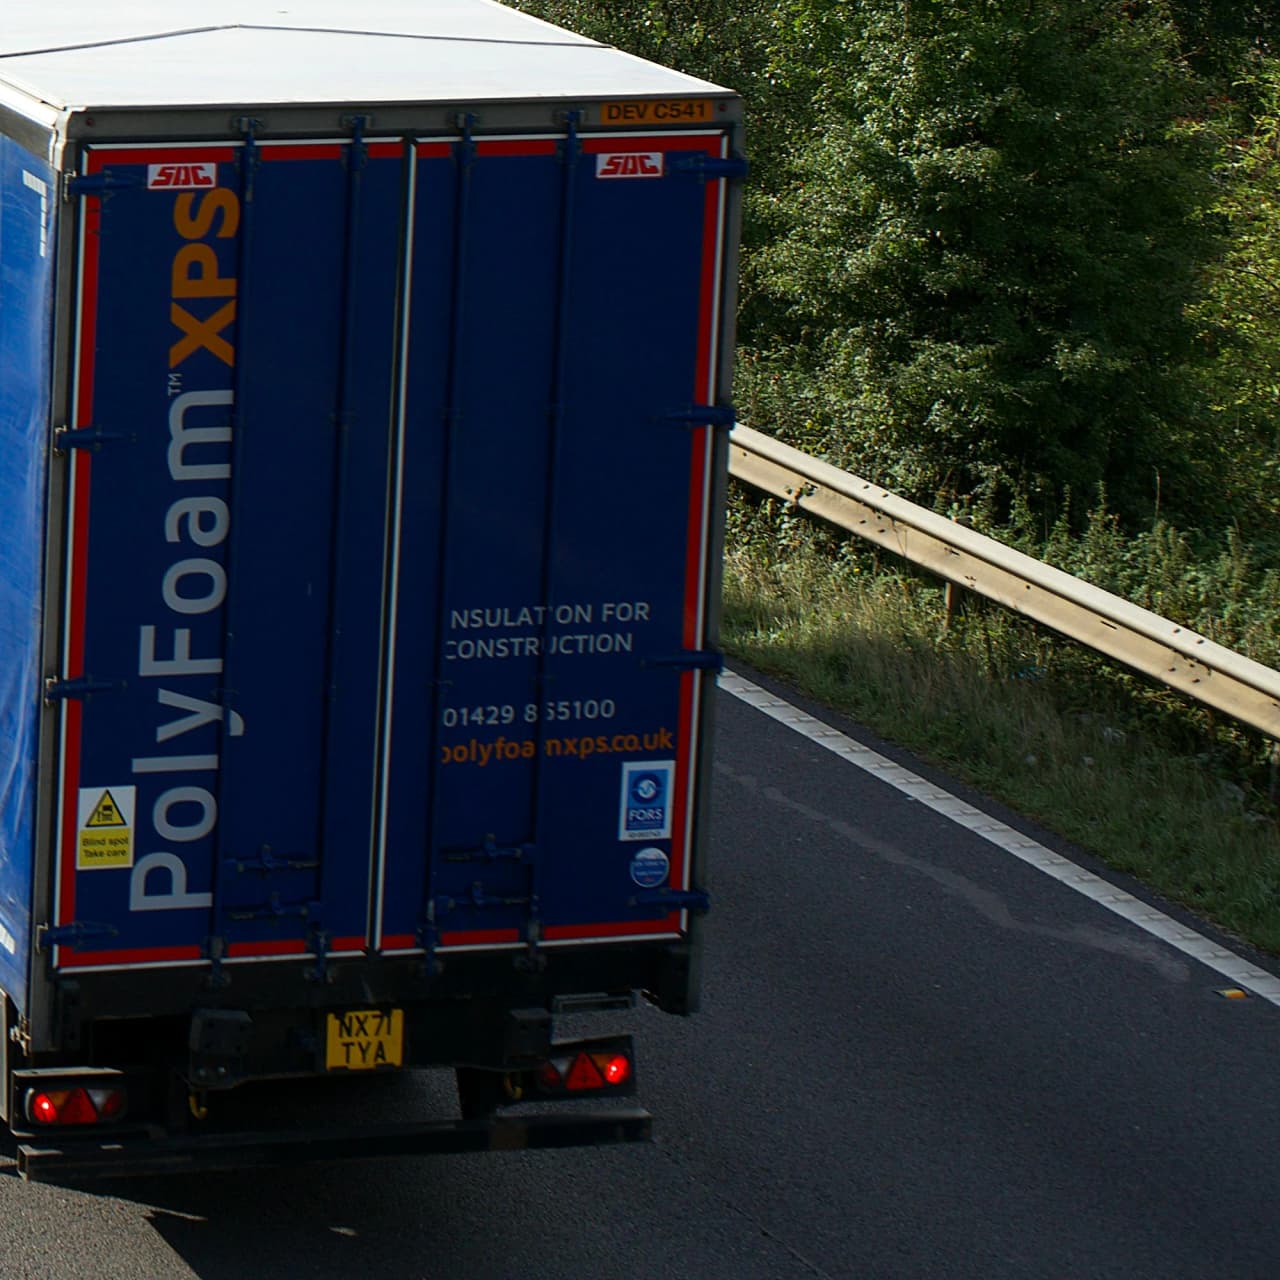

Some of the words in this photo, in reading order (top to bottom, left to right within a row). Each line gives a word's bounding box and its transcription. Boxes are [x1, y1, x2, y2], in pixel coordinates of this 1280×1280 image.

[607, 104, 647, 120] DEV
[654, 103, 705, 119] C541
[168, 186, 240, 369] XPS
[450, 604, 592, 629] NSULATON
[601, 602, 650, 623] FOR
[443, 705, 515, 727] 01429
[629, 808, 663, 821] FORS
[82, 838, 106, 846] Blind
[109, 837, 129, 847] spot
[83, 849, 104, 858] Take
[106, 849, 127, 857] care
[339, 1014, 391, 1038] NX71
[341, 1040, 387, 1064] TYA
